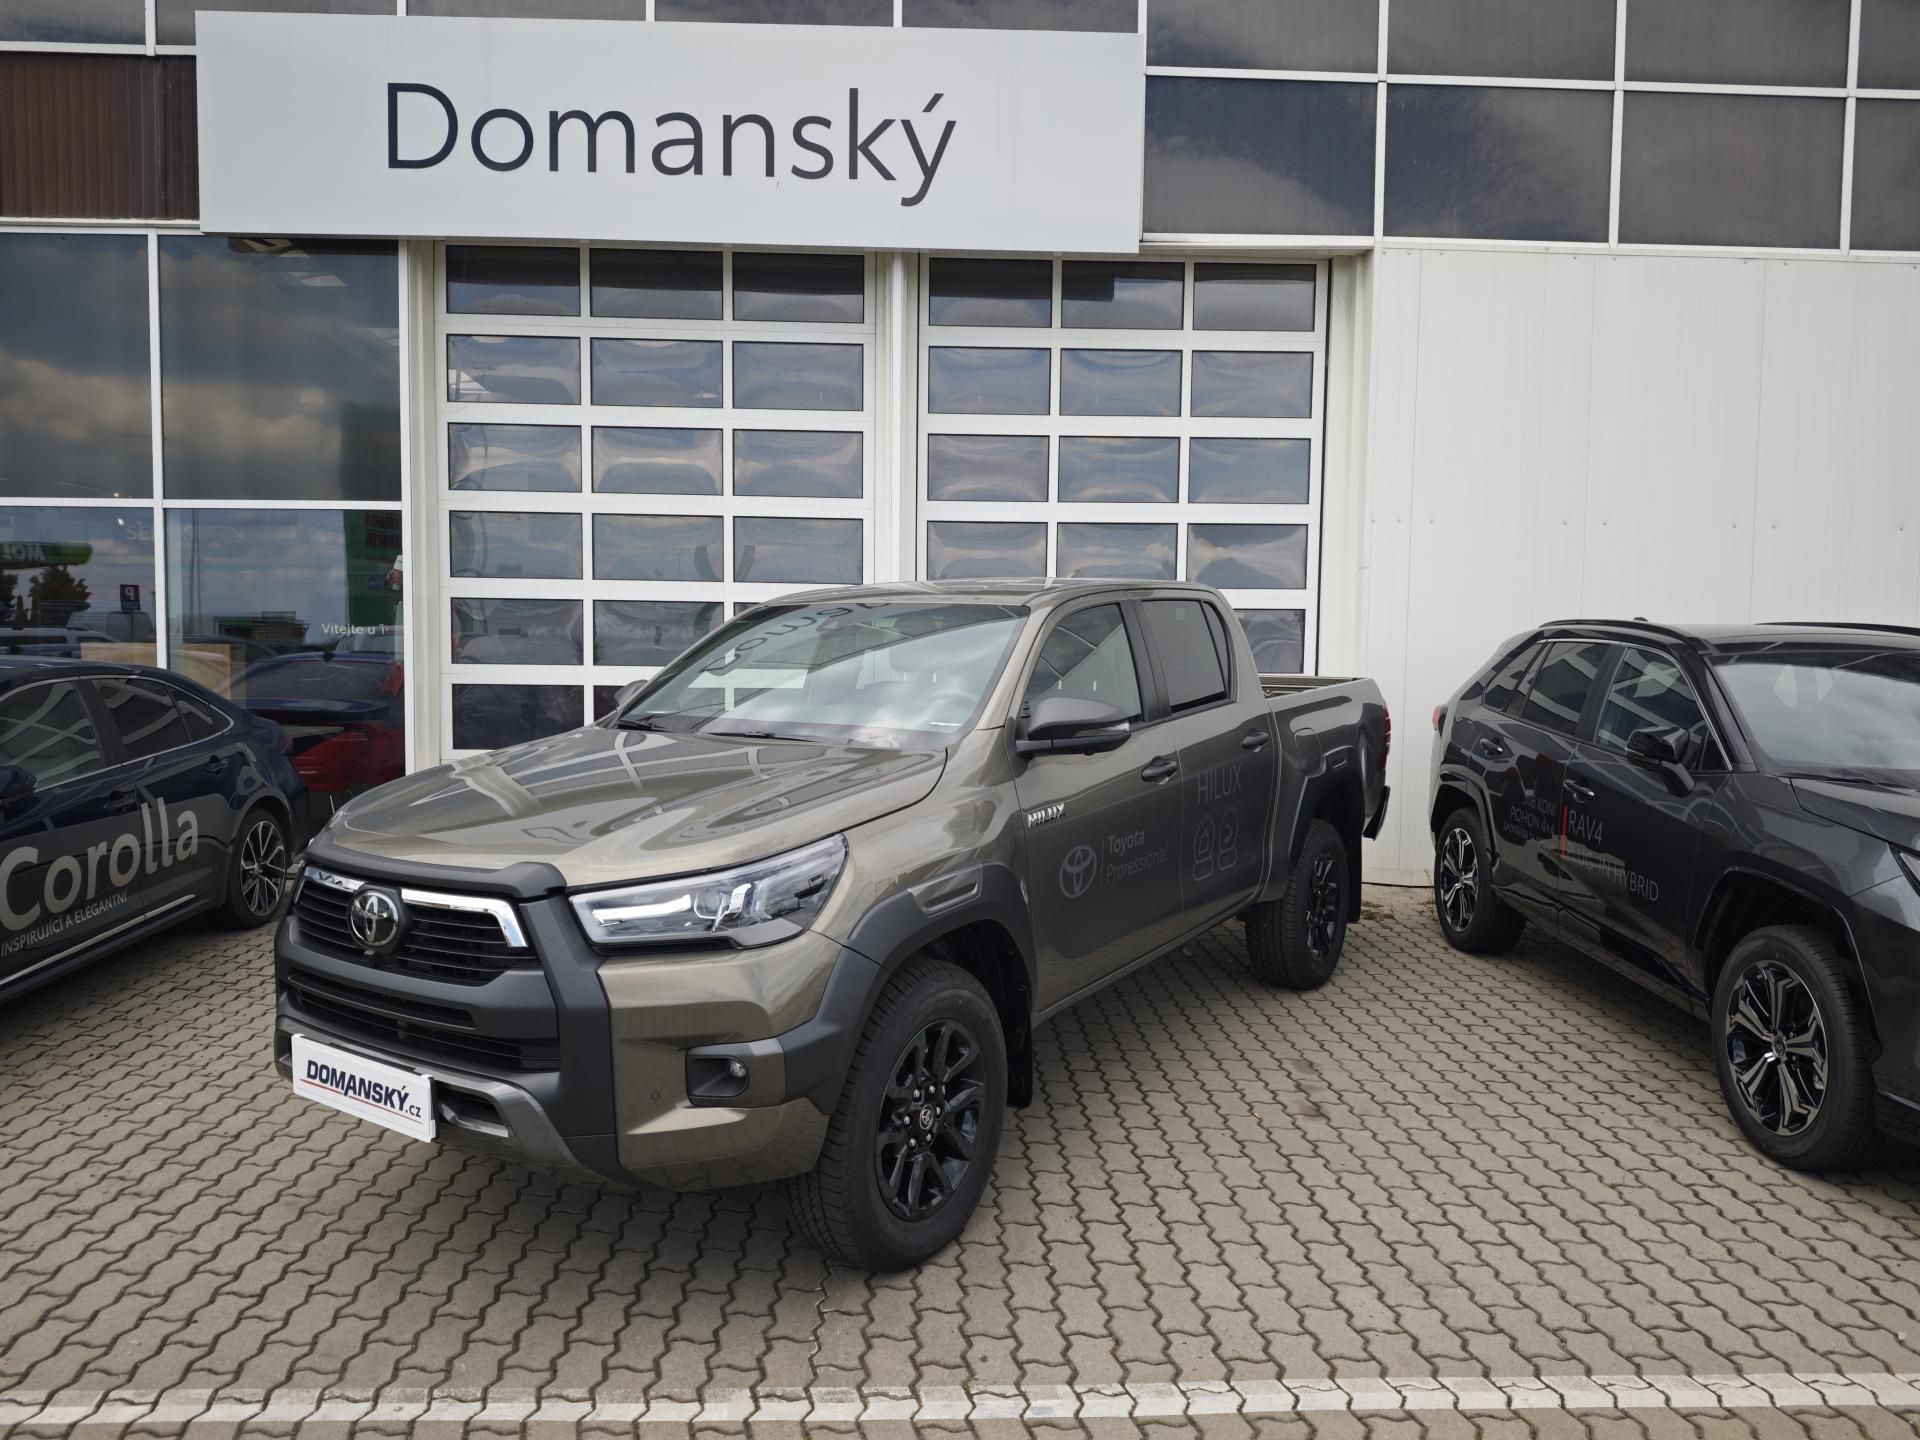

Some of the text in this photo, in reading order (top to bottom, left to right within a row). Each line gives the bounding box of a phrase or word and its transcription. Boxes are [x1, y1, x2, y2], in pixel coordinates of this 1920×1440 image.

[387, 82, 957, 207] Domanský
[1198, 762, 1242, 804] HILUX
[1510, 805, 1540, 831] POHON
[1568, 810, 1604, 844] RAV4
[1106, 842, 1168, 883] Professional
[1107, 829, 1145, 856] Toyota
[0, 797, 198, 931] Corolla
[1614, 863, 1659, 902] HYBRID
[1, 890, 128, 958] INSPIRUJÍCÍ A ELEGANTNÍ
